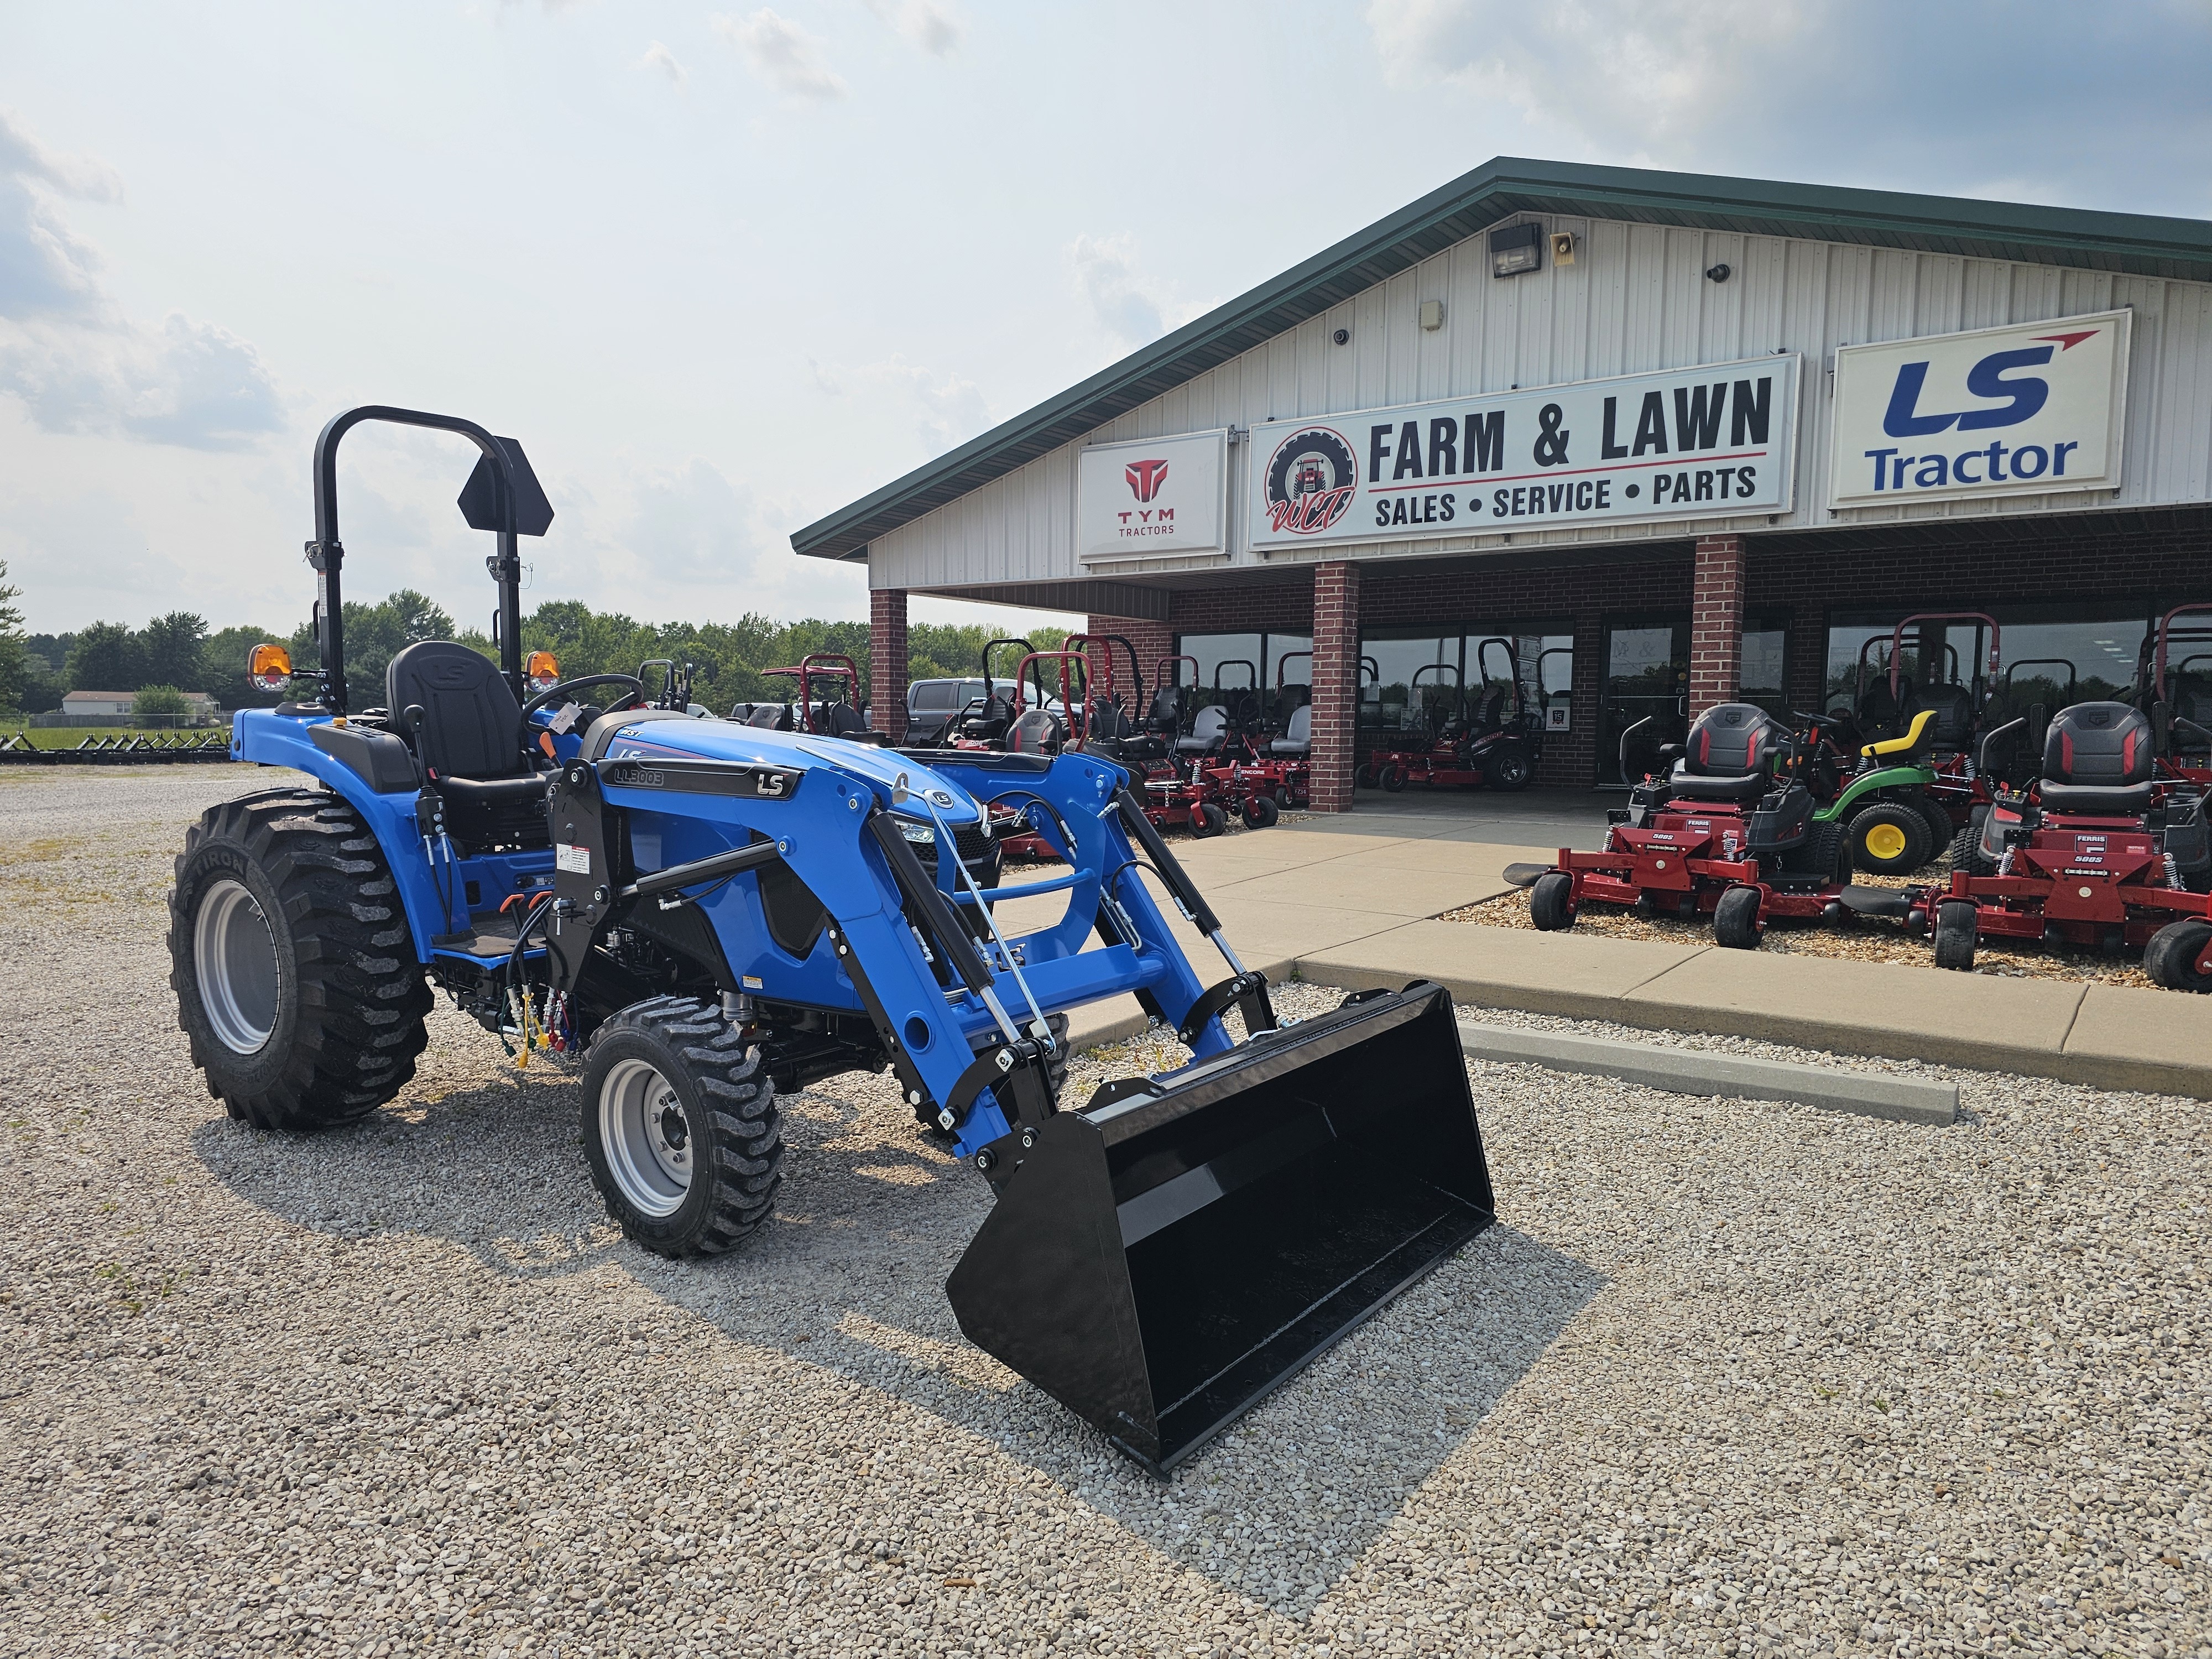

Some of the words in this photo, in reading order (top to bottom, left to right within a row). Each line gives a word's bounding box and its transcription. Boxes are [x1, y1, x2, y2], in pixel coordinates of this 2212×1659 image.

[1883, 346, 2054, 437] LS
[1369, 410, 1505, 482] FARM
[1533, 403, 1569, 467] &
[1601, 377, 1772, 460] LAWN
[1865, 440, 2078, 491] Tractor
[1376, 494, 1455, 526] SALES
[1493, 479, 1610, 517] SERVICE
[1653, 466, 1756, 504] PARTS
[1118, 508, 1174, 524] TYM
[1266, 486, 1355, 533] WCT
[1119, 525, 1173, 537] TRACTORS
[433, 664, 466, 684] LS
[620, 729, 644, 737] HST
[614, 768, 664, 786] LL3003
[757, 774, 784, 796] LS
